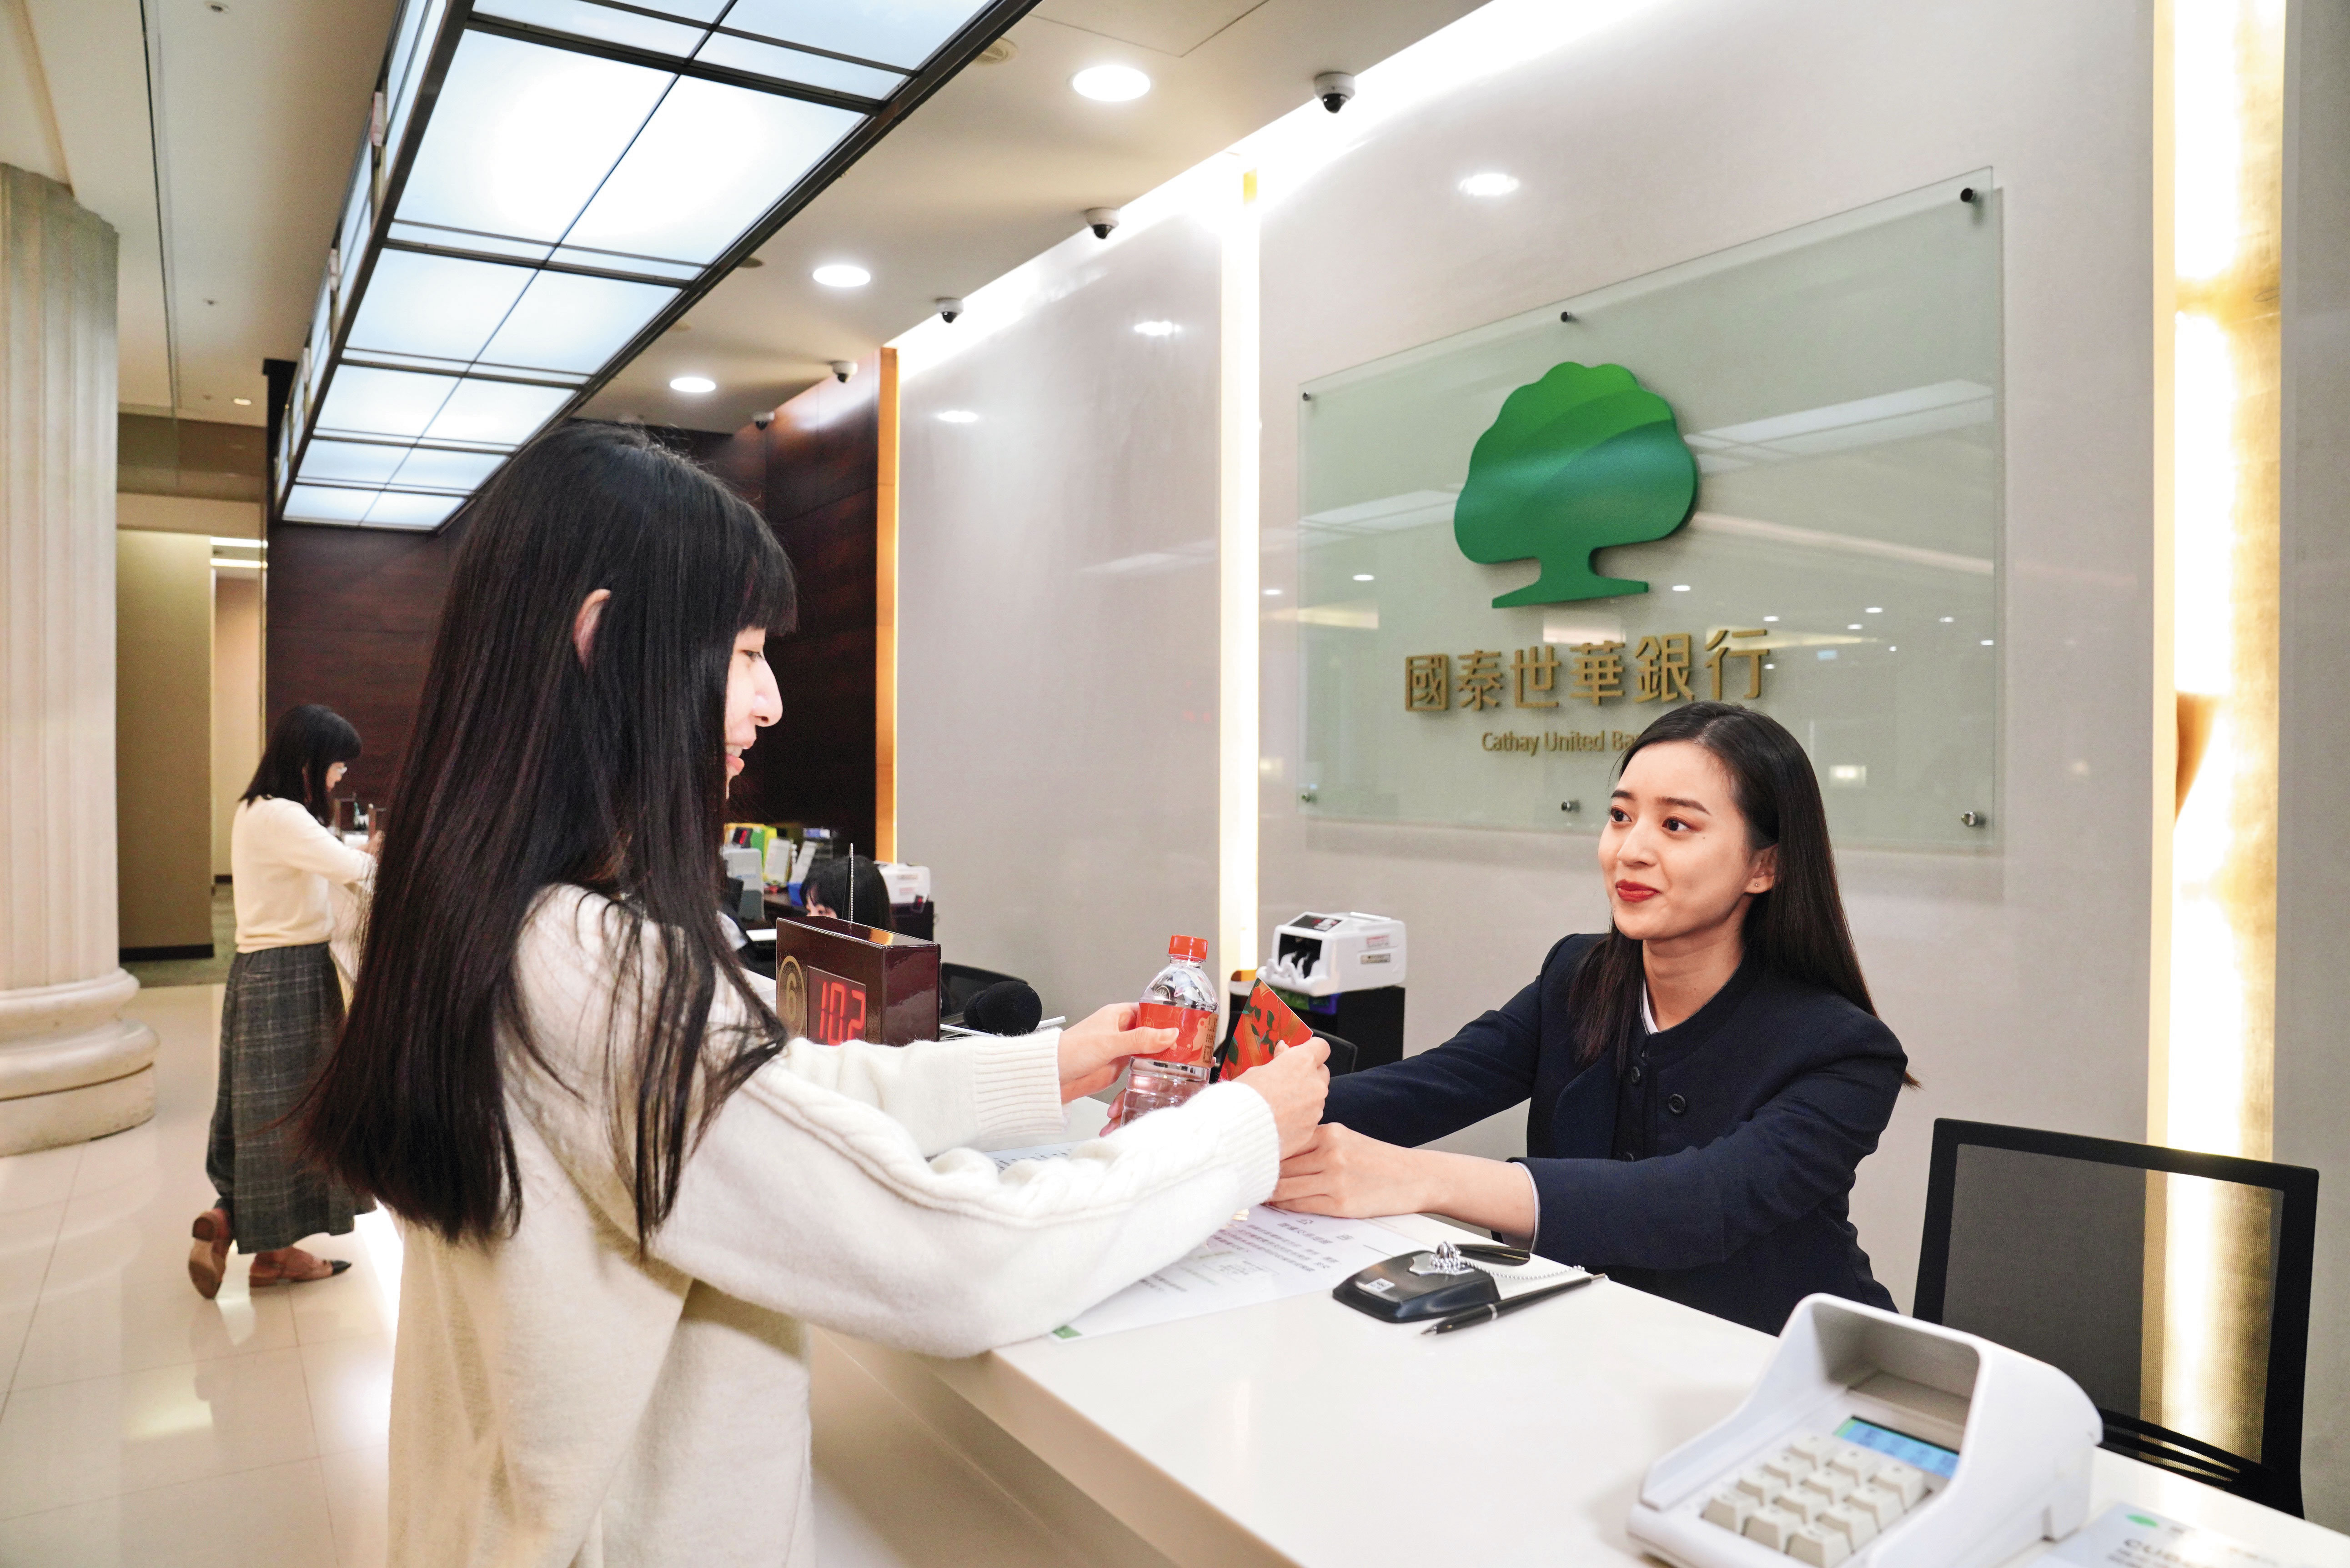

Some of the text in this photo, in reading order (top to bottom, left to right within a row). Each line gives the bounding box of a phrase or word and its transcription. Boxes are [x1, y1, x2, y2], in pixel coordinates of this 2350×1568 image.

[1405, 629, 1770, 711] 國泰世華銀行
[1482, 730, 1641, 757] Cathay United Ba
[786, 973, 797, 1022] 6
[819, 981, 865, 1046] 102
